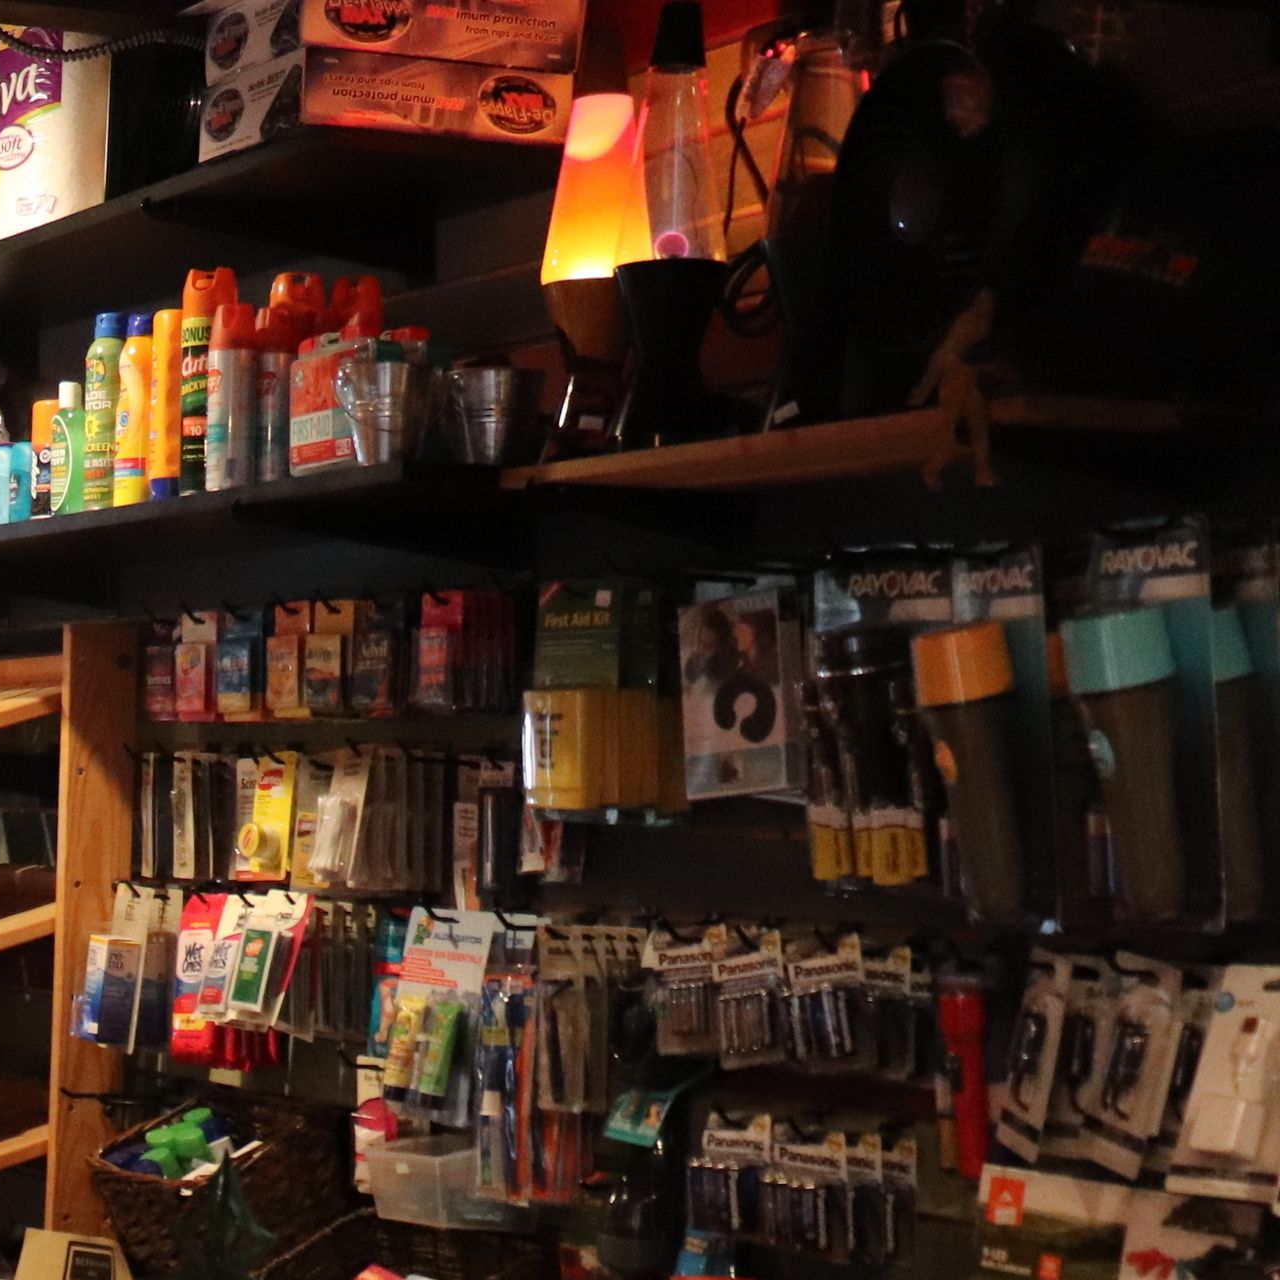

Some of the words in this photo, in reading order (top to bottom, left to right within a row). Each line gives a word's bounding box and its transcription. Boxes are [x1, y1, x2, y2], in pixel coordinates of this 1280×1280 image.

[493, 14, 556, 29] protection
[465, 25, 489, 36] from
[513, 31, 532, 41] and
[332, 87, 395, 102] protection
[1100, 541, 1200, 575] RAYOVAC
[847, 569, 939, 598] RAYOVAC
[544, 614, 574, 628] First
[575, 614, 591, 628] Aid
[593, 612, 611, 626] Kit
[185, 943, 205, 960] Wet
[183, 958, 204, 974] Ones
[717, 957, 780, 978] Panasonic
[793, 960, 859, 979] Panasonic
[705, 1133, 765, 1152] Panasonic
[778, 1147, 840, 1169] Panasonic
